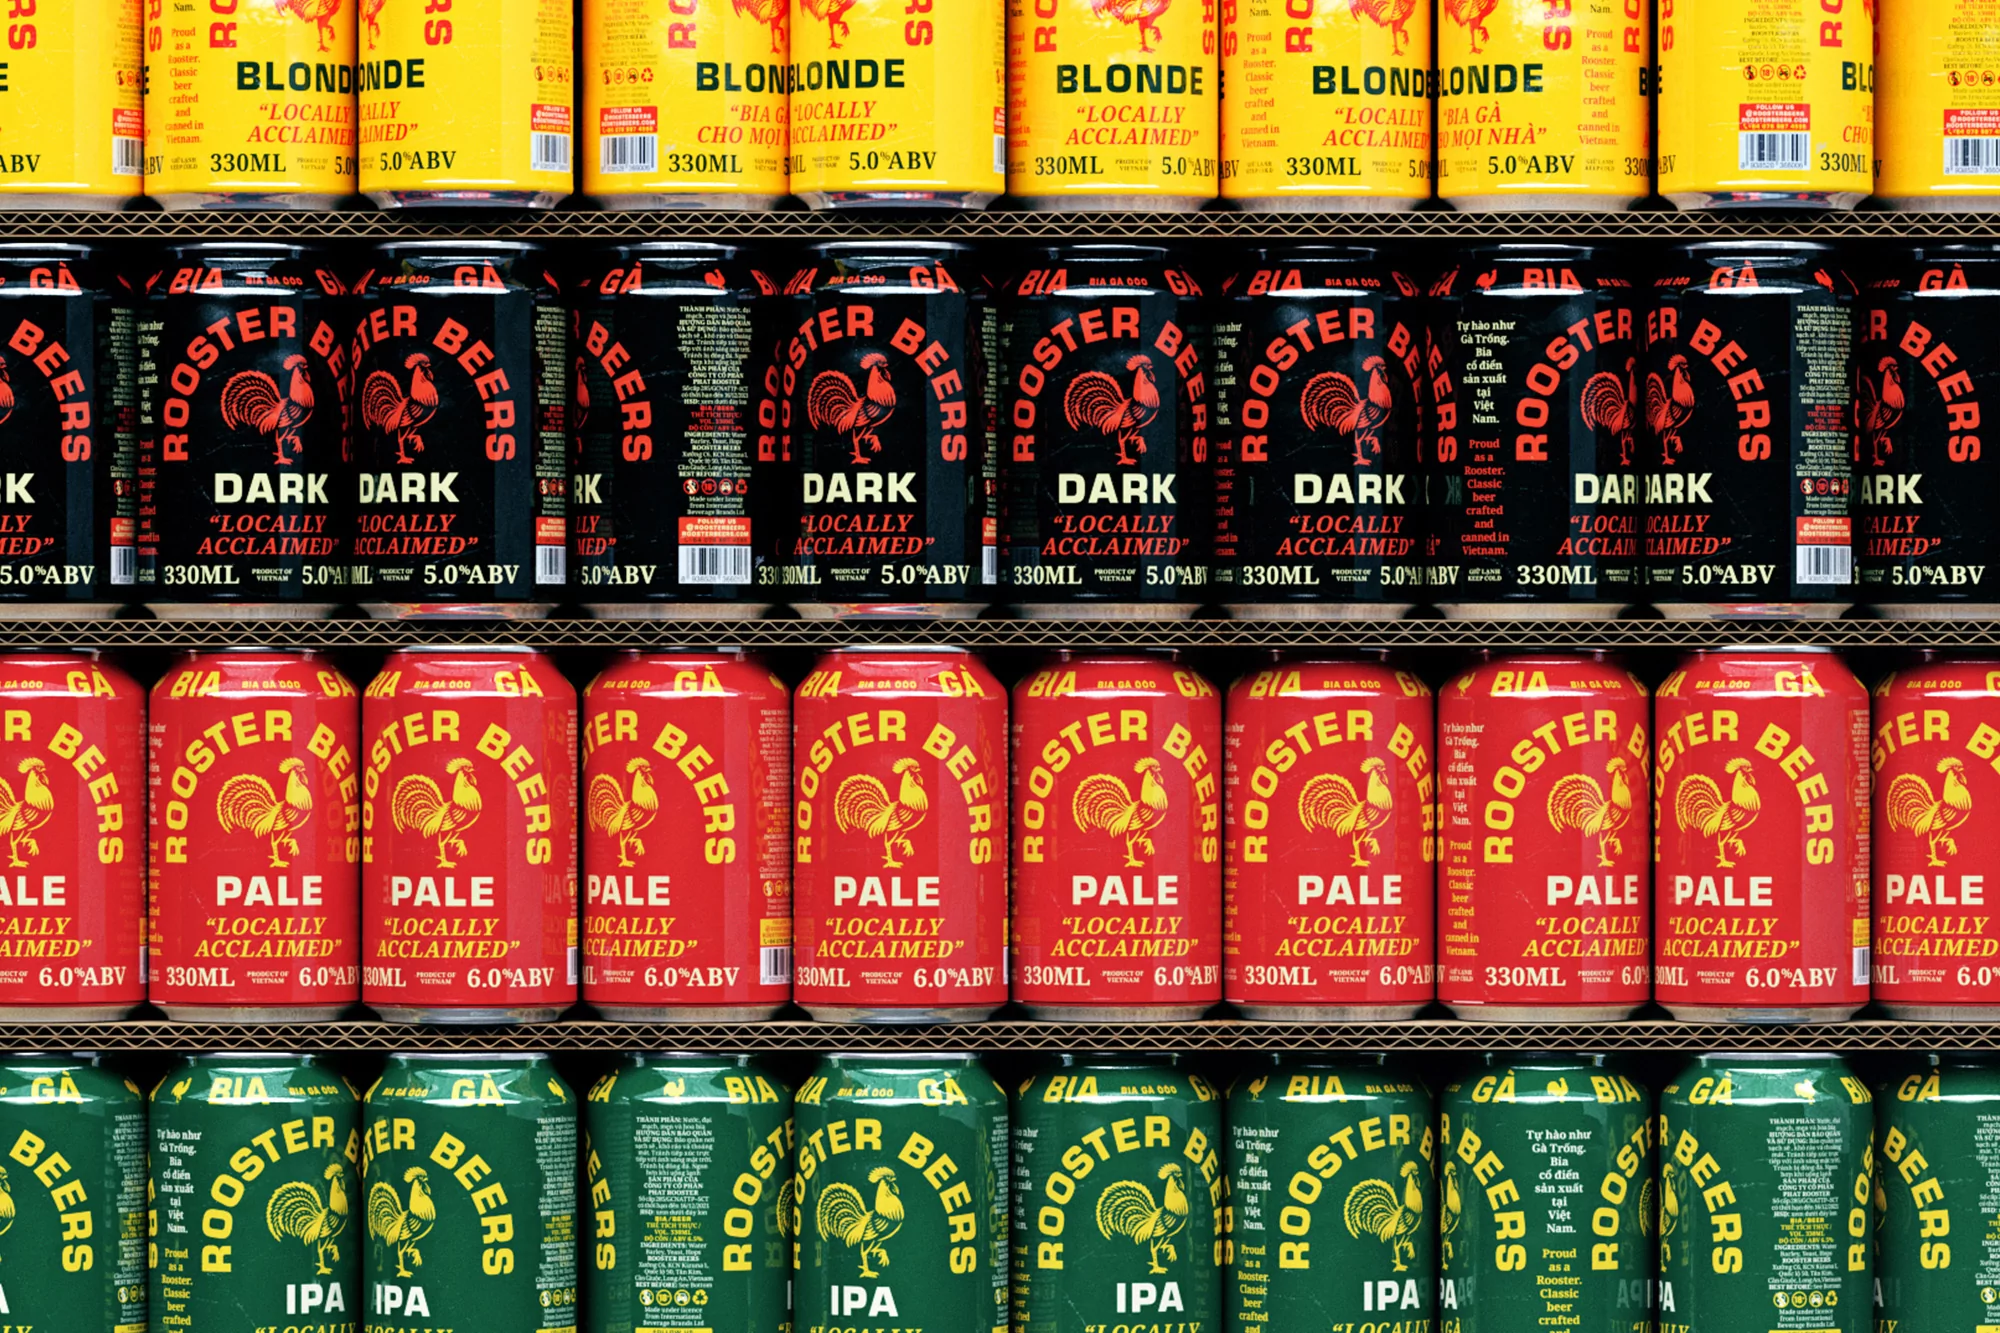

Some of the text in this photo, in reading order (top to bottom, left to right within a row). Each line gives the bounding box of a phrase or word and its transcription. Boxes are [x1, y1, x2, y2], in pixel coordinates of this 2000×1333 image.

[1057, 64, 1202, 95] BLONDE
[1077, 105, 1185, 123] “LOCALLY
[1476, 101, 1501, 123] GÀ
[1065, 128, 1199, 146] ACCLAIMED”
[1488, 123, 1547, 144] NHÀ”
[211, 154, 286, 172] 330ML
[381, 151, 456, 171] 5.0%ABV
[669, 154, 742, 173] 330ML
[850, 151, 936, 170] 5.0%ABV
[1035, 156, 1103, 175] 330ML
[1287, 157, 1361, 175] 330ML
[1489, 155, 1574, 174] 5.0%ABV
[1017, 267, 1069, 296] BIA
[1456, 320, 1516, 333] Tự hào như
[1461, 333, 1509, 346] Gà Trống.
[1475, 347, 1492, 357] Bia
[163, 305, 297, 462] ROOSTER
[1013, 306, 1141, 463] ROOSTER
[1462, 373, 1507, 384] sản xuất
[7, 318, 91, 463] BEERS
[431, 316, 517, 462] BEERS
[889, 316, 968, 463] BEERS
[1476, 386, 1491, 399] tại
[1688, 317, 1772, 462] BEERS
[1474, 401, 1494, 412] Việt
[1472, 414, 1500, 424] Nam.
[1469, 438, 1500, 449] Proud
[1474, 453, 1494, 462] as a
[1464, 466, 1506, 476] Rooster.
[215, 473, 328, 503] DARK
[803, 472, 917, 504] DARK
[1059, 473, 1176, 503] DARK
[1295, 474, 1405, 504] DARK
[1467, 478, 1502, 489] Classic
[1472, 492, 1496, 502] beer
[1466, 505, 1504, 515] crafted
[210, 515, 326, 533] “LOCALLY
[801, 514, 915, 533] “LOCALLY
[1054, 515, 1174, 533] “LOCALLY
[1474, 519, 1494, 529] and
[197, 537, 339, 555] ACCLAIMED”
[793, 537, 936, 555] ACCLAIMED”
[1042, 537, 1189, 555] ACCLAIMED”
[1461, 532, 1510, 542] canned in
[1462, 545, 1508, 556] Vietnam.
[164, 565, 240, 584] 330ML
[424, 565, 520, 584] 5.0%ABV
[881, 565, 970, 584] 5.0%ABV
[1014, 565, 1082, 585] 330ML
[1517, 565, 1597, 584] 330ML
[1682, 565, 1776, 584] 5.0%ABV
[66, 665, 116, 698] GÀ
[165, 708, 294, 864] ROOSTER
[475, 723, 552, 866] BEERS
[1022, 708, 1148, 864] ROOSTER
[1243, 708, 1374, 864] ROOSTER
[1753, 722, 1835, 866] BEERS
[217, 876, 322, 906] PALE
[835, 876, 939, 906] PALE
[1073, 876, 1178, 905] PALE
[1299, 875, 1401, 905] PALE
[1548, 875, 1637, 905] PALE
[207, 918, 326, 935] “LOCALLY
[826, 918, 945, 936] “LOCALLY
[1536, 917, 1640, 934] “LOCALLY
[194, 939, 341, 957] ACCLAIMED”
[817, 940, 964, 958] ACCLAIMED”
[39, 966, 126, 986] 6.0%ABV
[167, 967, 235, 986] 330ML
[645, 967, 739, 986] 6.0%ABV
[1024, 966, 1090, 986] 330ML
[1486, 967, 1566, 986] 330ML
[1746, 968, 1837, 987] 6.0%ABV
[725, 1076, 778, 1102] BIA
[1470, 1071, 1515, 1103] GÀ
[1897, 1071, 1943, 1103] GÀ
[1526, 1129, 1592, 1142] Tự hào như
[1532, 1142, 1586, 1156] Gà Trống.
[1550, 1156, 1568, 1166] Bia
[201, 1115, 335, 1273] ROOSTER
[1037, 1114, 1171, 1271] ROOSTER
[1534, 1183, 1583, 1193] sản xuất
[8, 1128, 94, 1273] BEERS
[429, 1132, 515, 1275] BEERS
[897, 1130, 978, 1275] BEERS
[1456, 1126, 1528, 1272] BEERS
[1552, 1196, 1567, 1208] tại
[1673, 1128, 1743, 1273] BEERS
[1548, 1209, 1571, 1222] Việt
[1546, 1223, 1577, 1233] Nam.
[1542, 1248, 1577, 1259] Proud
[1548, 1263, 1571, 1272] as a
[1536, 1276, 1582, 1285] Rooster.
[287, 1282, 345, 1314] IPA
[831, 1285, 898, 1317] IPA
[1117, 1282, 1184, 1313] IPA
[1540, 1288, 1579, 1298] Classic
[1546, 1302, 1572, 1312] beer
[1538, 1315, 1580, 1325] crafted
